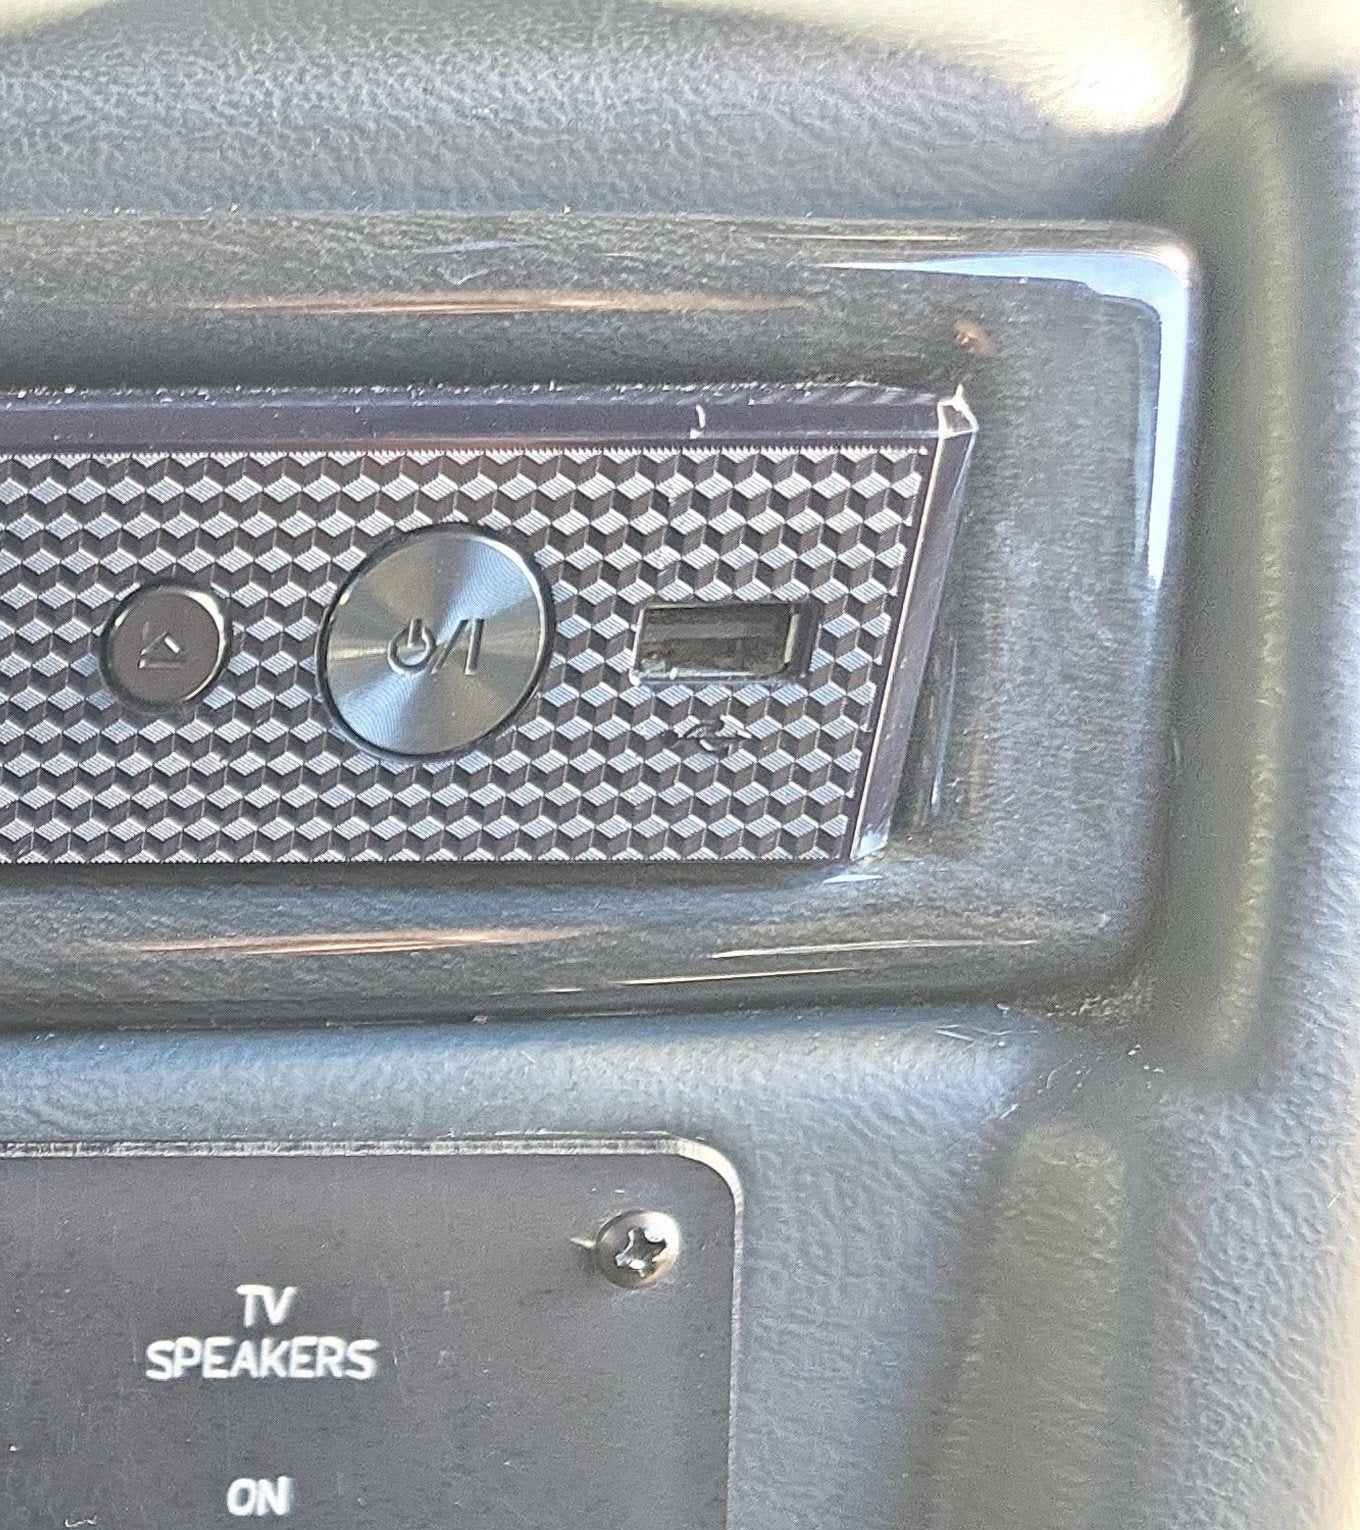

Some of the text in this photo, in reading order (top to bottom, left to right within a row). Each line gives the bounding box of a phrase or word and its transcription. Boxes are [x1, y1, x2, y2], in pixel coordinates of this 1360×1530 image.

[235, 1283, 299, 1327] TV
[145, 1336, 379, 1381] SPEAKERS
[226, 1475, 293, 1518] ON
